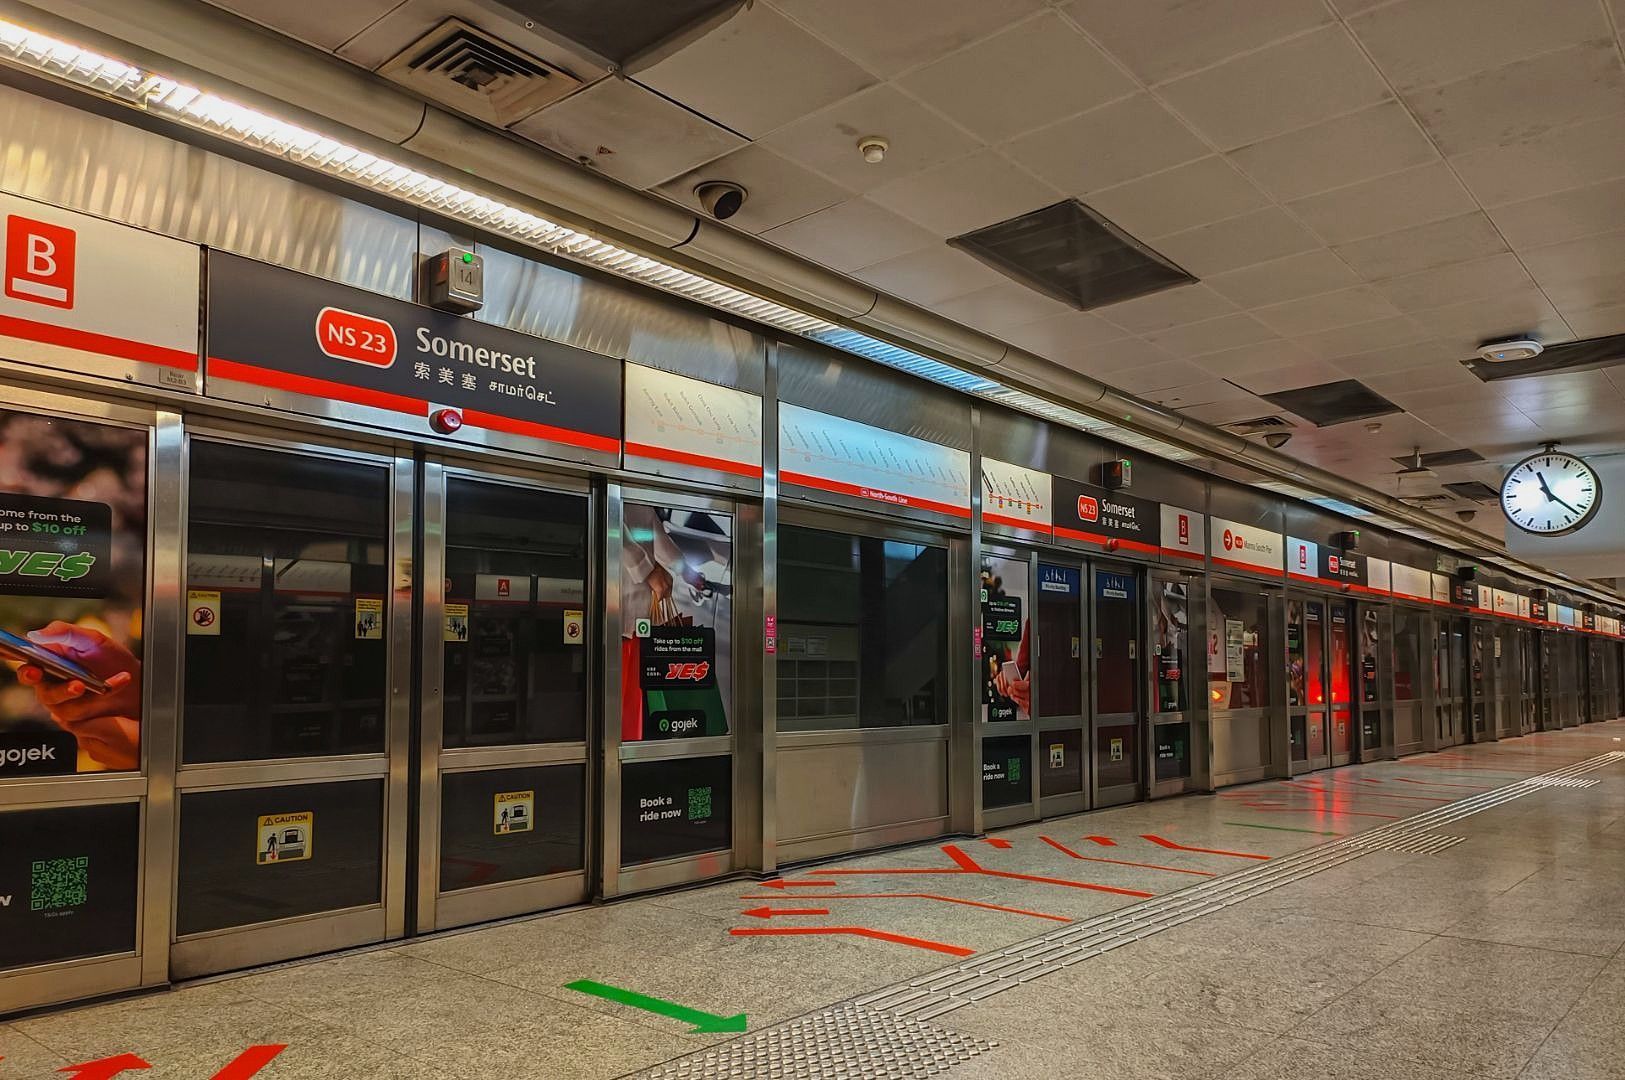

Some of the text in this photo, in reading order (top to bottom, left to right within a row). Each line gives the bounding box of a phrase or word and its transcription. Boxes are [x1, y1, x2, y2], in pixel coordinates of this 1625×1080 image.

[27, 233, 57, 277] B
[460, 269, 472, 285] 14
[328, 322, 387, 354] NS 23
[416, 327, 536, 379] Somerset
[1101, 498, 1136, 519] Somerset
[28, 510, 58, 521] from
[60, 513, 81, 523] the
[0, 521, 87, 536] up to $10 off
[665, 661, 710, 681] YE$
[671, 717, 698, 732] gojek
[640, 796, 673, 808] Book a
[274, 814, 308, 824] CAUTION
[640, 809, 682, 822] ride now
